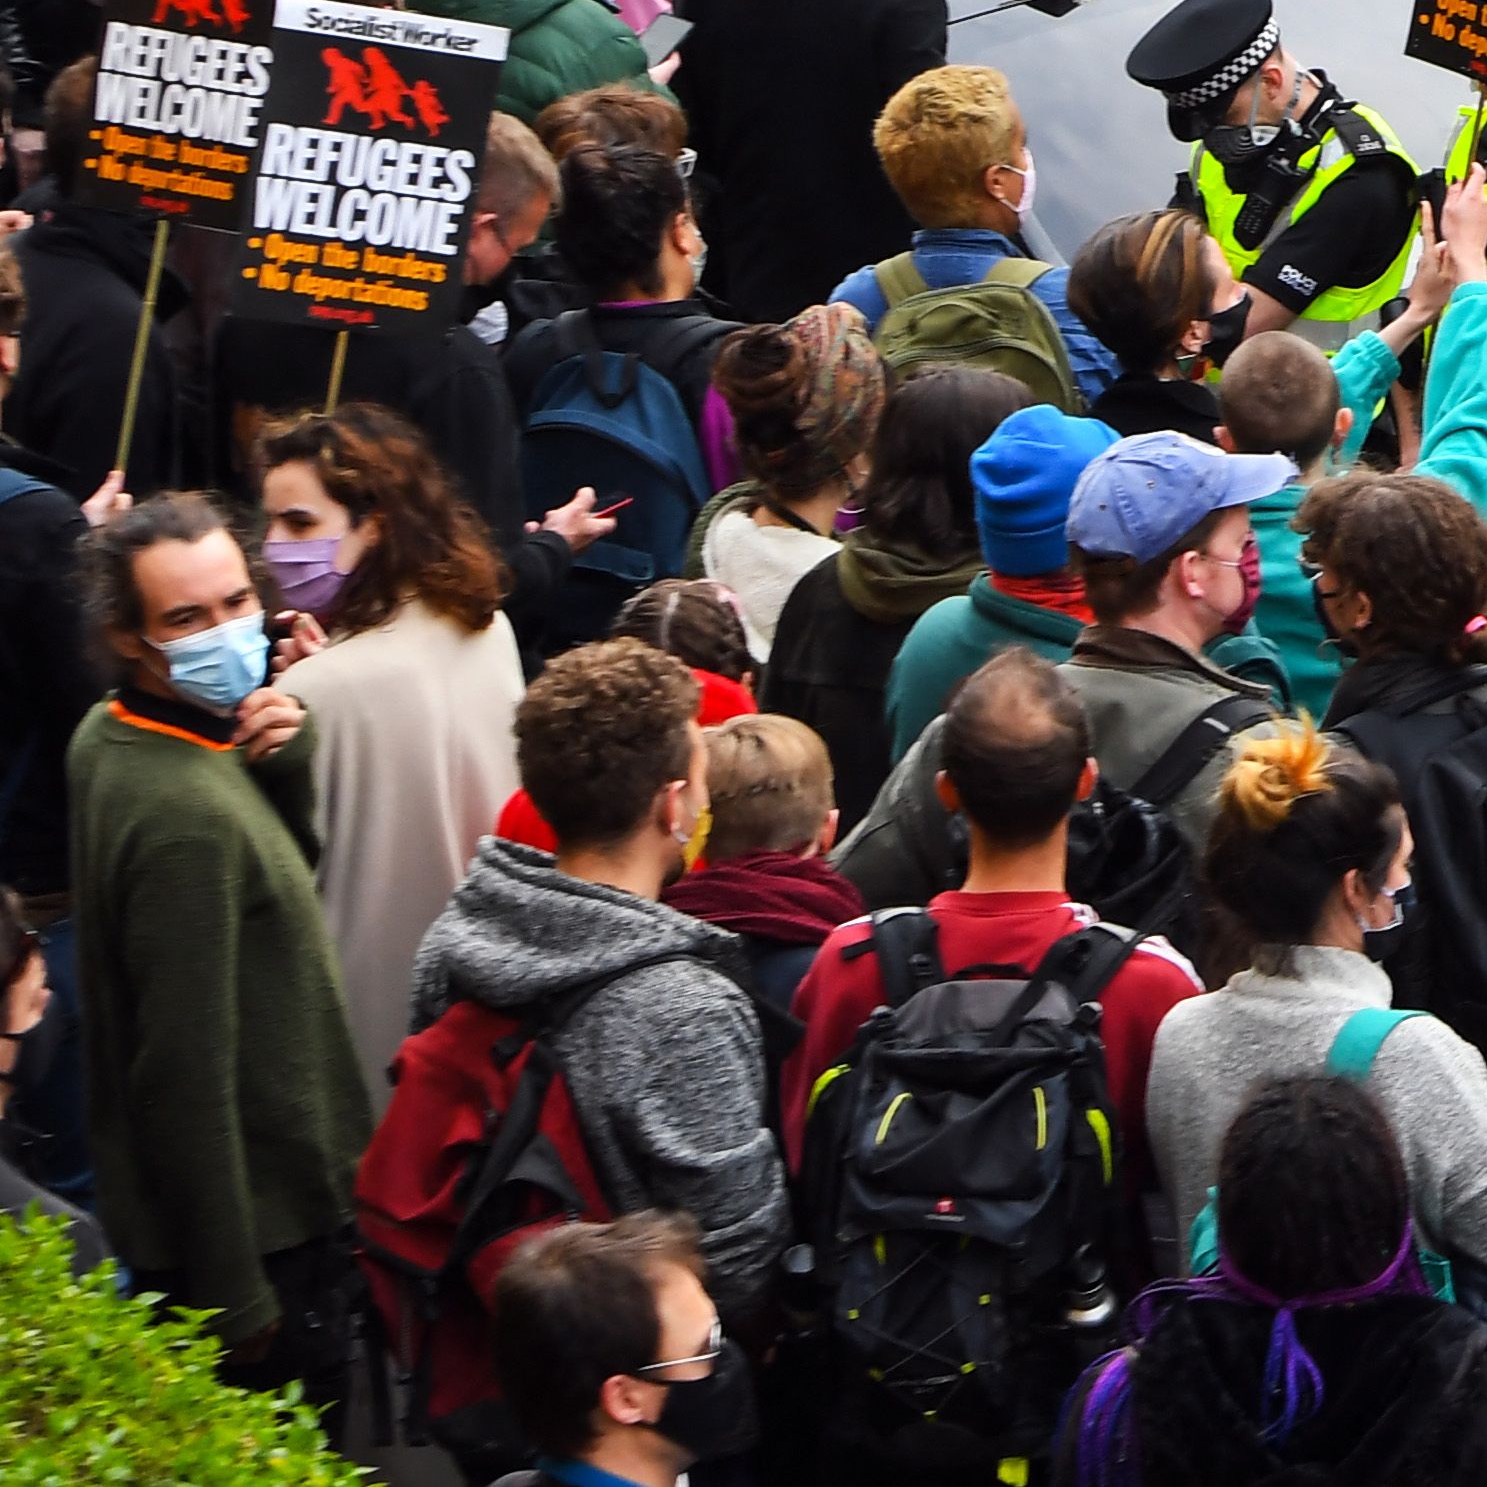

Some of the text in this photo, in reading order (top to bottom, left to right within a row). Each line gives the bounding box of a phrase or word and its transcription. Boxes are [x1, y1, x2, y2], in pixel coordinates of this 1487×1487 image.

[305, 6, 479, 53] Socialist Worker
[1430, 14, 1456, 43] No
[102, 21, 274, 97] REFUGEES
[95, 73, 264, 148] WELCOME
[102, 126, 250, 175] Open the borders
[261, 122, 476, 202] REFUGEES
[96, 154, 234, 201] No deportations
[253, 176, 465, 256] WELCOME
[264, 234, 447, 283] Open the borders
[258, 264, 429, 311] No deportations
